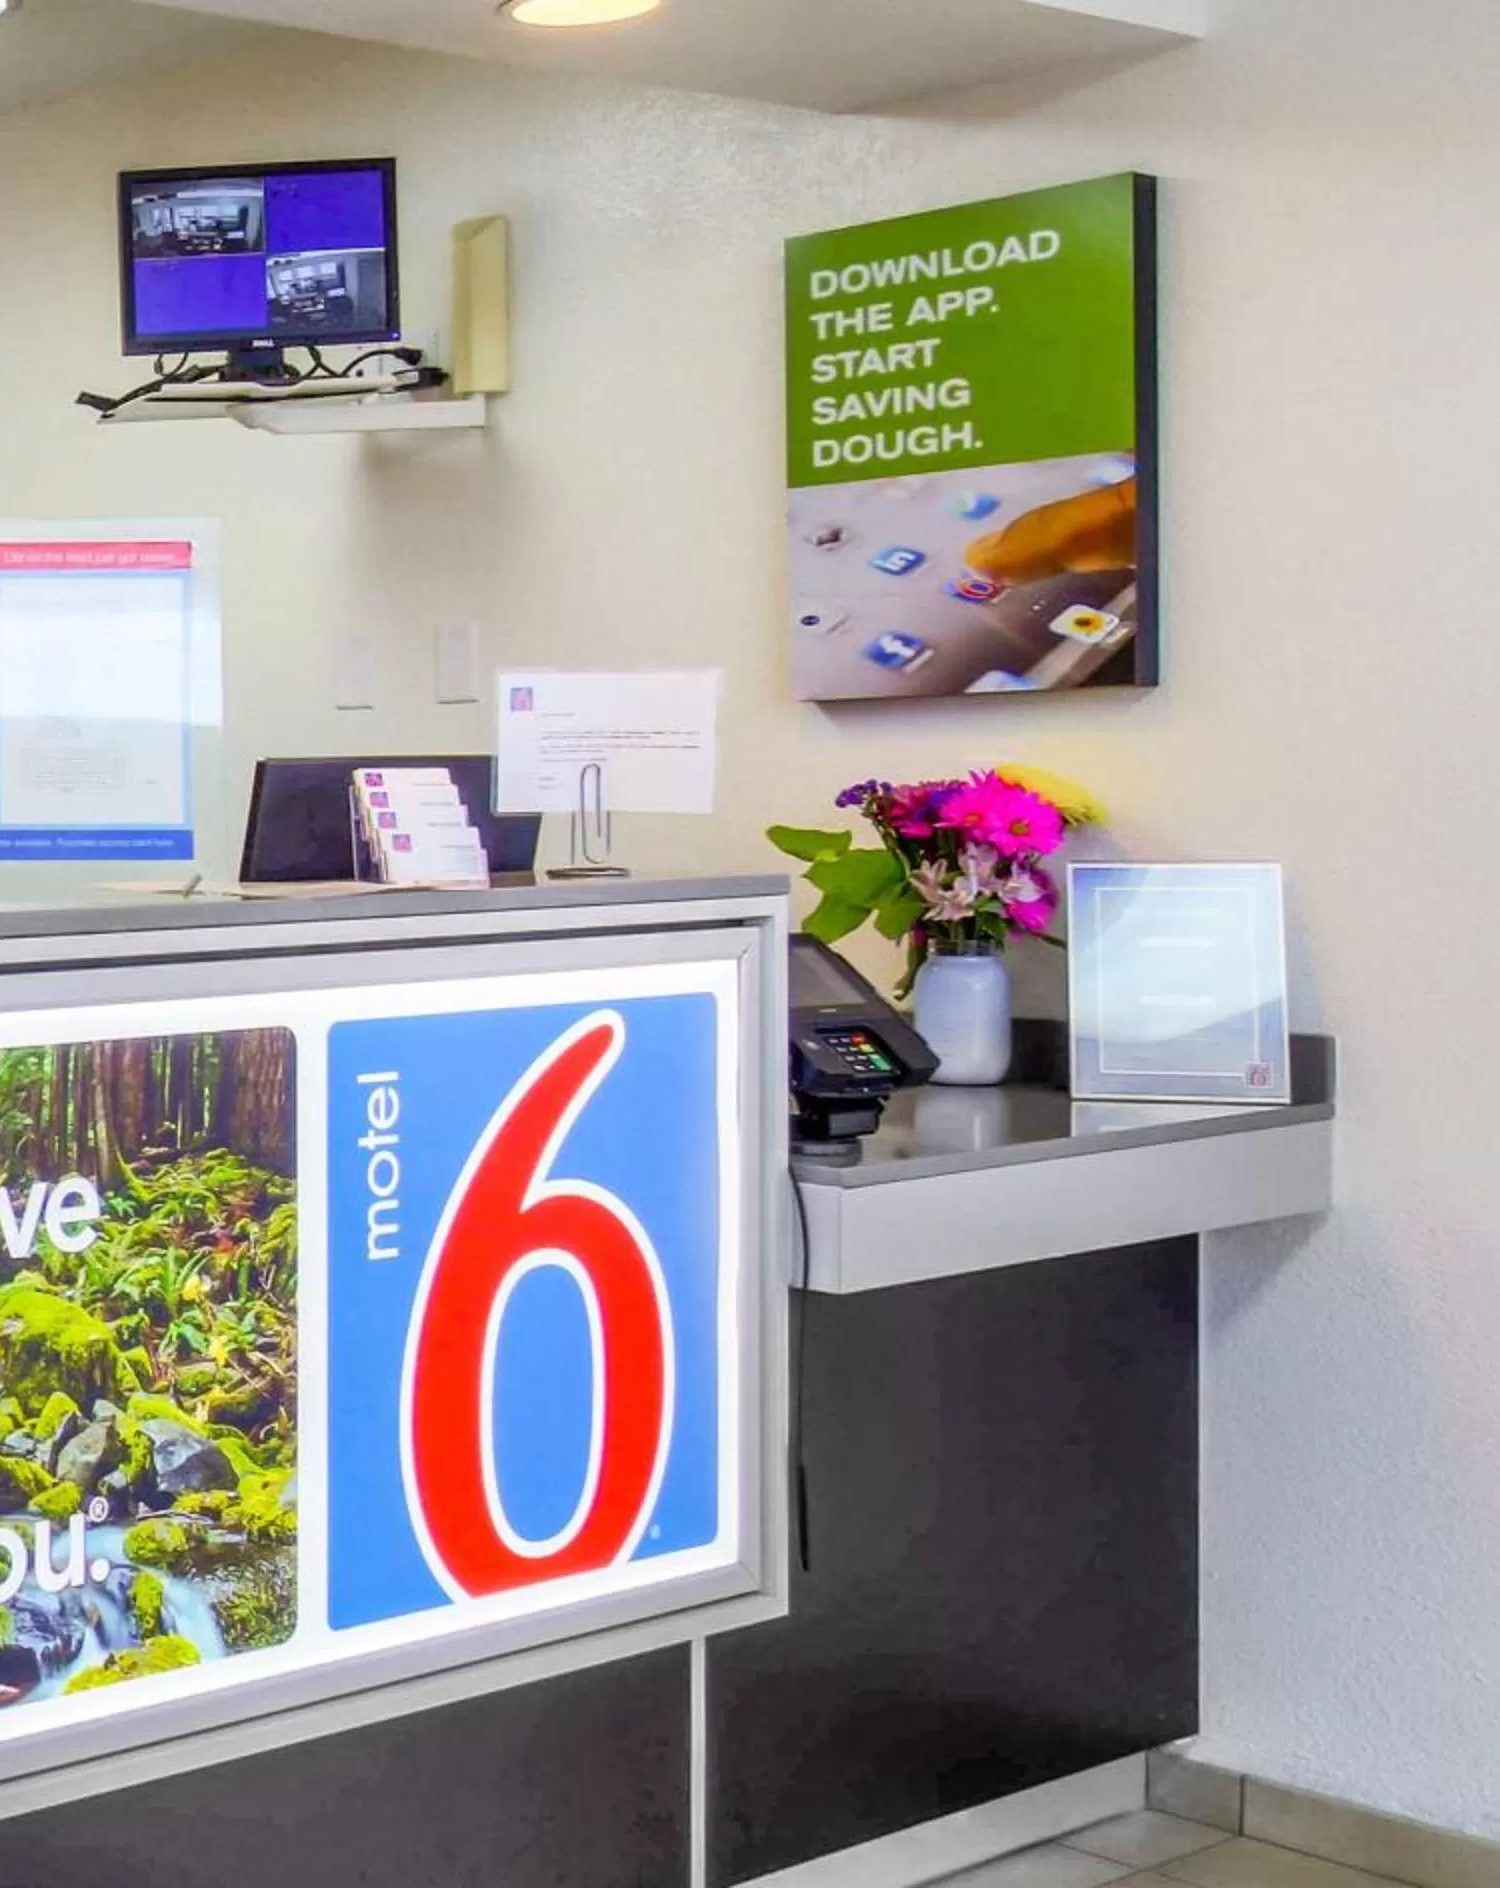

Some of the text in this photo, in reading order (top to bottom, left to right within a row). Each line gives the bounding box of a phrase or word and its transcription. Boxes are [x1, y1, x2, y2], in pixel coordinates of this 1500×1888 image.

[810, 229, 1061, 300] DOWNLOAD
[810, 286, 999, 340] THE APP.
[811, 337, 941, 384] START
[811, 378, 972, 425] SAVING
[812, 421, 984, 468] DOUGH.
[356, 1008, 675, 1602] motel 6
